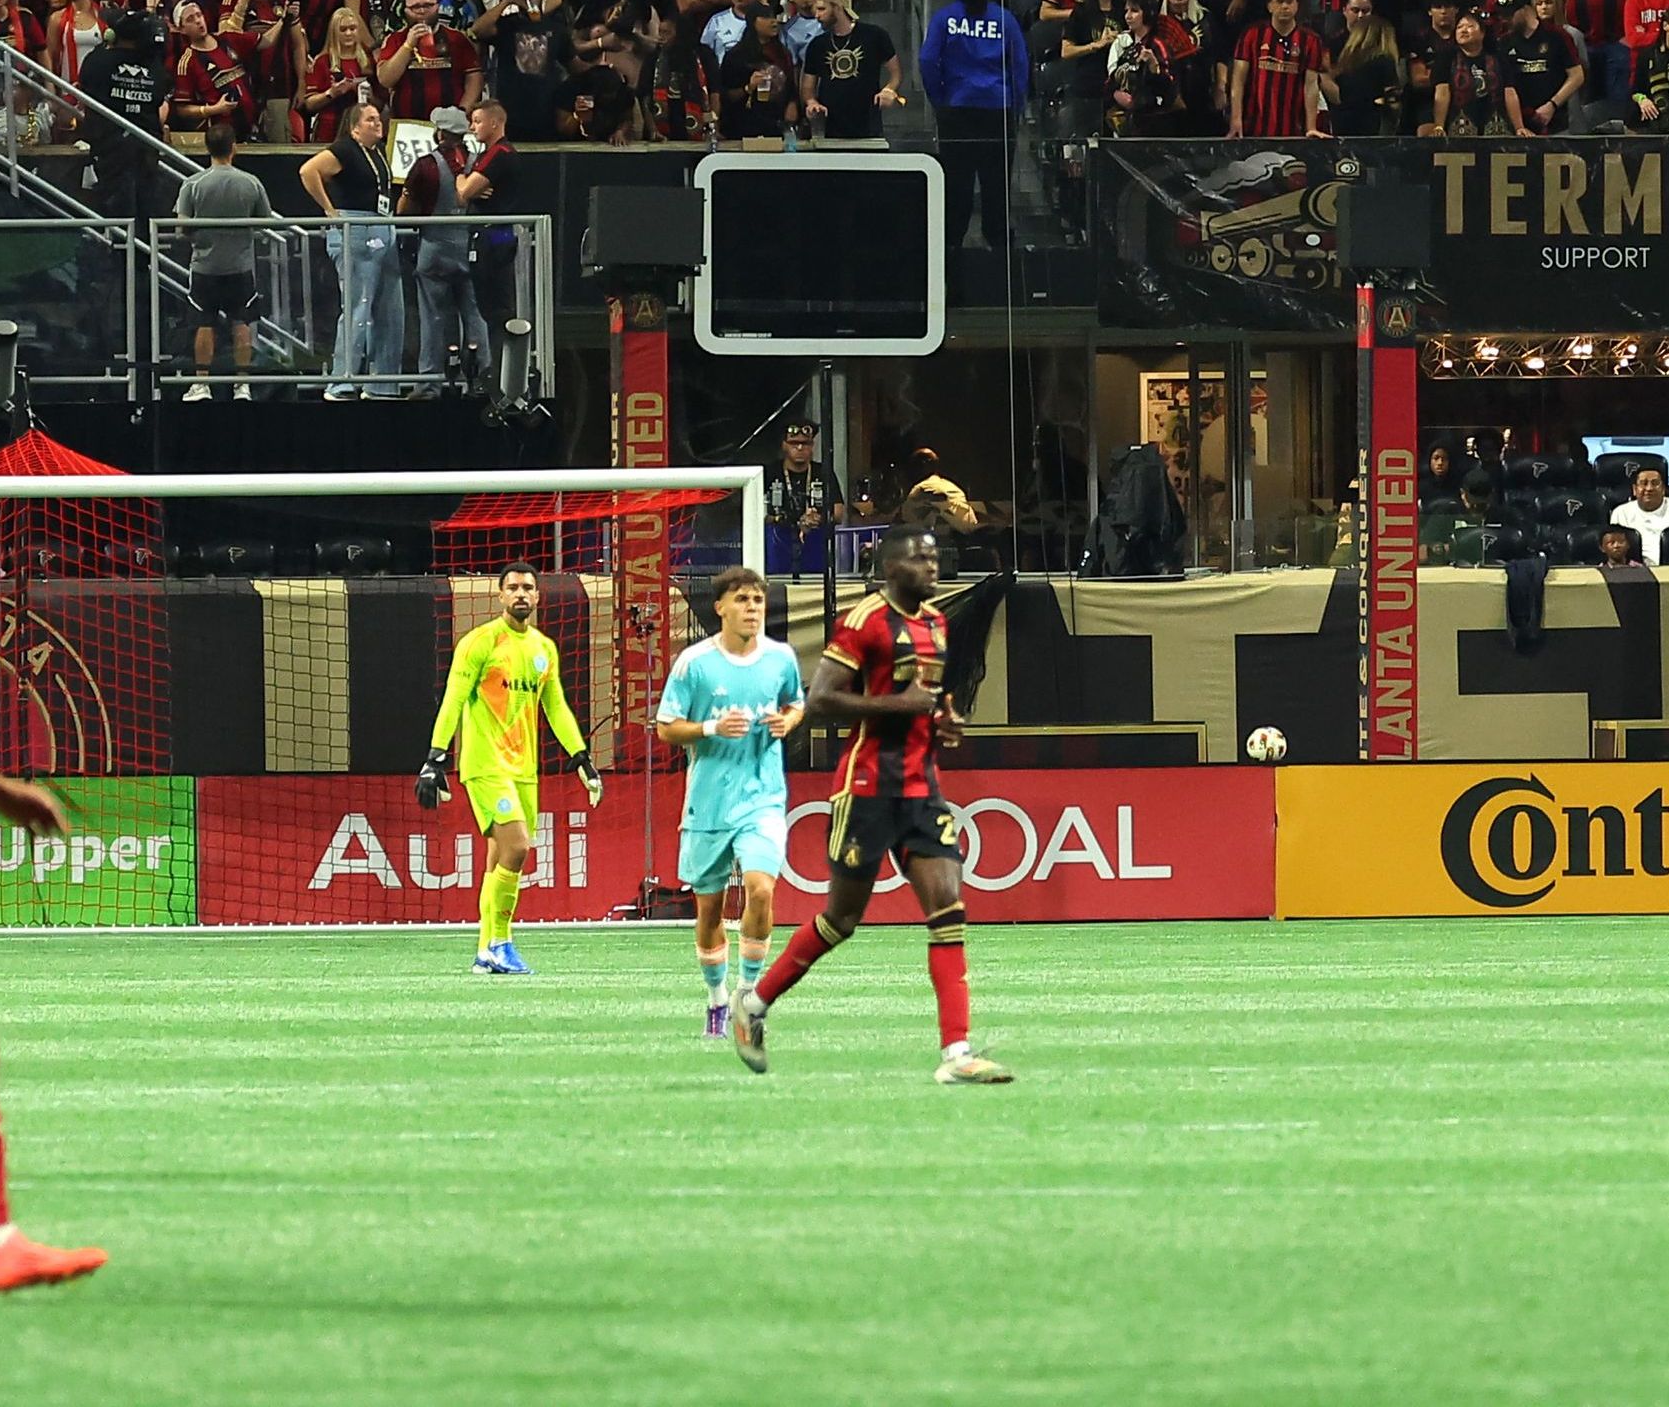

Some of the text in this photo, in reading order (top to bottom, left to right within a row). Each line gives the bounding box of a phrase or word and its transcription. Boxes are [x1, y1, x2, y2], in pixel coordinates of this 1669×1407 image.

[947, 17, 1002, 39] S.A.F.E.
[1540, 246, 1651, 269] SUPPORT
[1357, 448, 1370, 644] CONQUER
[1375, 448, 1414, 762] LANTA UNITED
[1357, 692, 1370, 761] ITE
